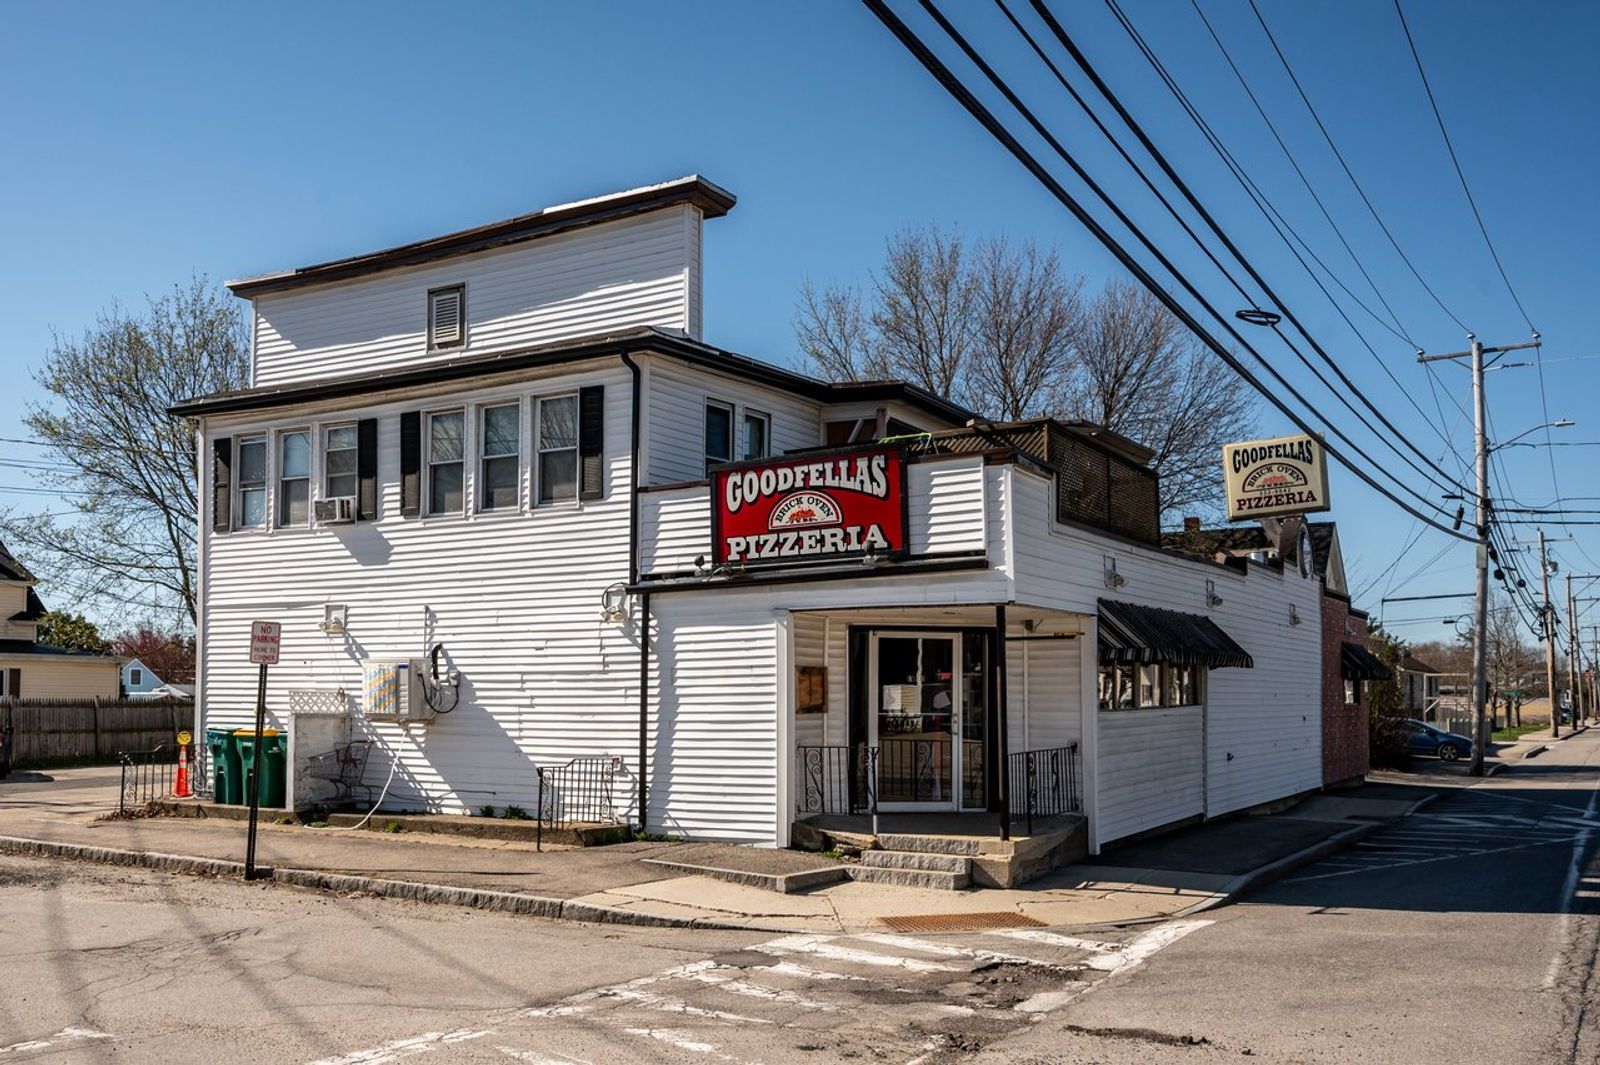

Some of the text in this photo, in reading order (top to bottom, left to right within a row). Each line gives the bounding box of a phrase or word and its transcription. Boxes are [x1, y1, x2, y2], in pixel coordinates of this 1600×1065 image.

[1233, 440, 1313, 473] GOODFELLAS
[726, 454, 887, 512] GOODFELLAS
[1247, 465, 1303, 487] BRICK OVEN
[775, 496, 834, 523] BRICK OVEN
[1236, 490, 1317, 511] PIZZERIA
[727, 524, 888, 561] PIZZERIA
[253, 635, 278, 644] PARKING
[260, 625, 272, 634] NO
